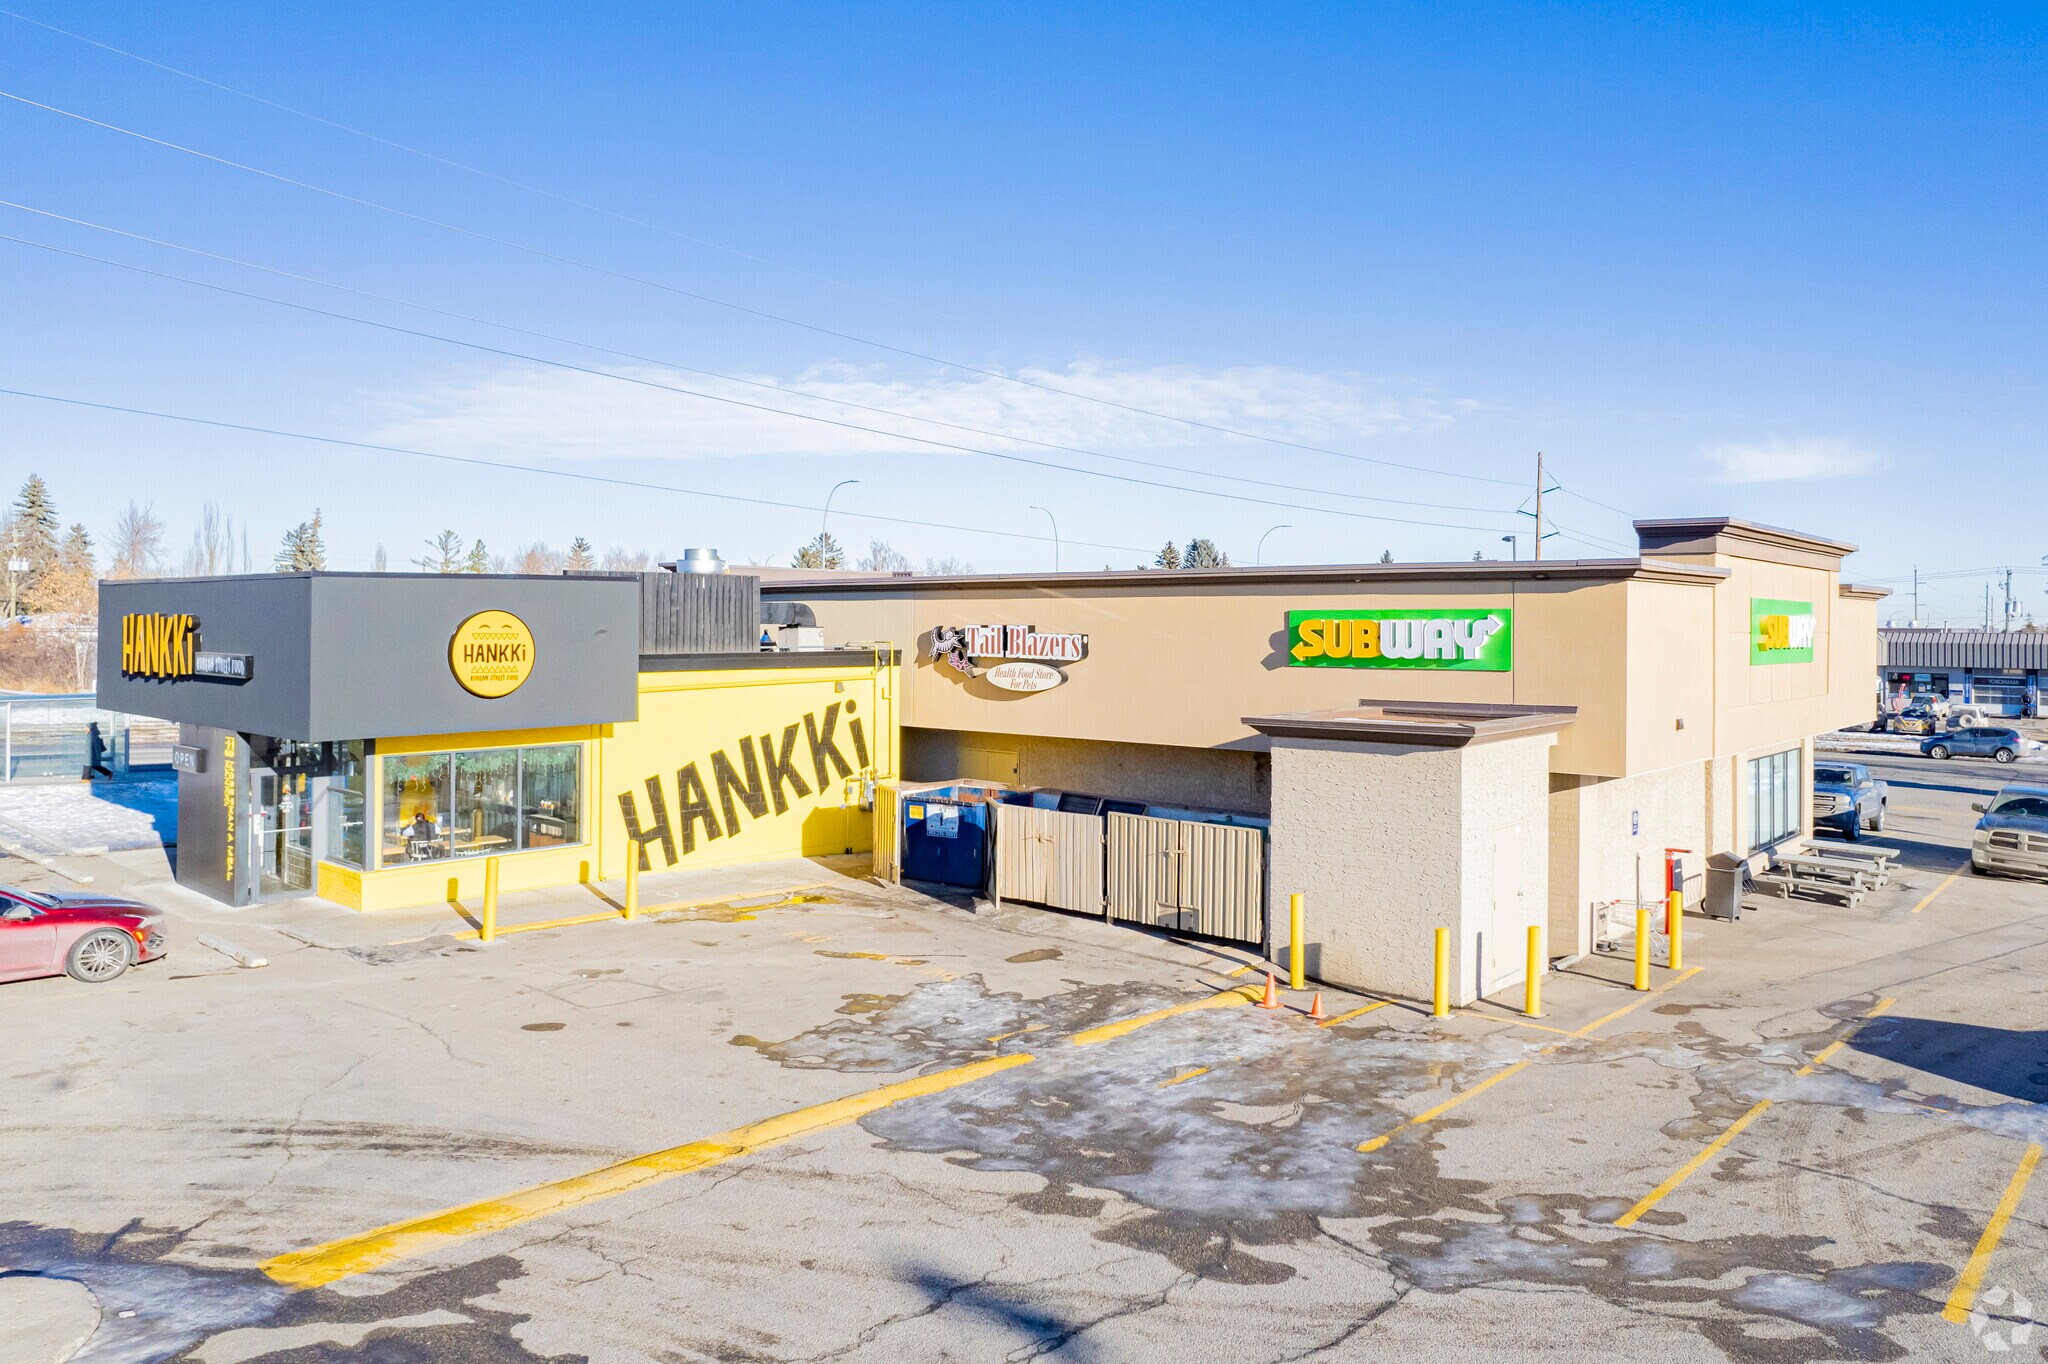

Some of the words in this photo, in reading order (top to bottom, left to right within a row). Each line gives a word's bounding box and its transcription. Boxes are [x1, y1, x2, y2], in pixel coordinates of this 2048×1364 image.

[967, 627, 1001, 655] Tail
[1009, 627, 1081, 658] Blazers
[1291, 615, 1504, 661] SUBWAY
[1757, 614, 1816, 651] SUBWAY
[122, 612, 193, 678] HANKKi
[464, 643, 526, 663] HANKKi
[215, 656, 231, 674] STREET
[231, 659, 245, 675] FOOD
[994, 667, 1017, 678] Health
[1017, 667, 1035, 679] Food
[1035, 668, 1054, 679] Store
[1009, 679, 1022, 689] For
[1022, 679, 1038, 690] Pets
[174, 751, 195, 767] OPEN
[618, 699, 870, 872] HANKKi
[227, 832, 234, 843] A
